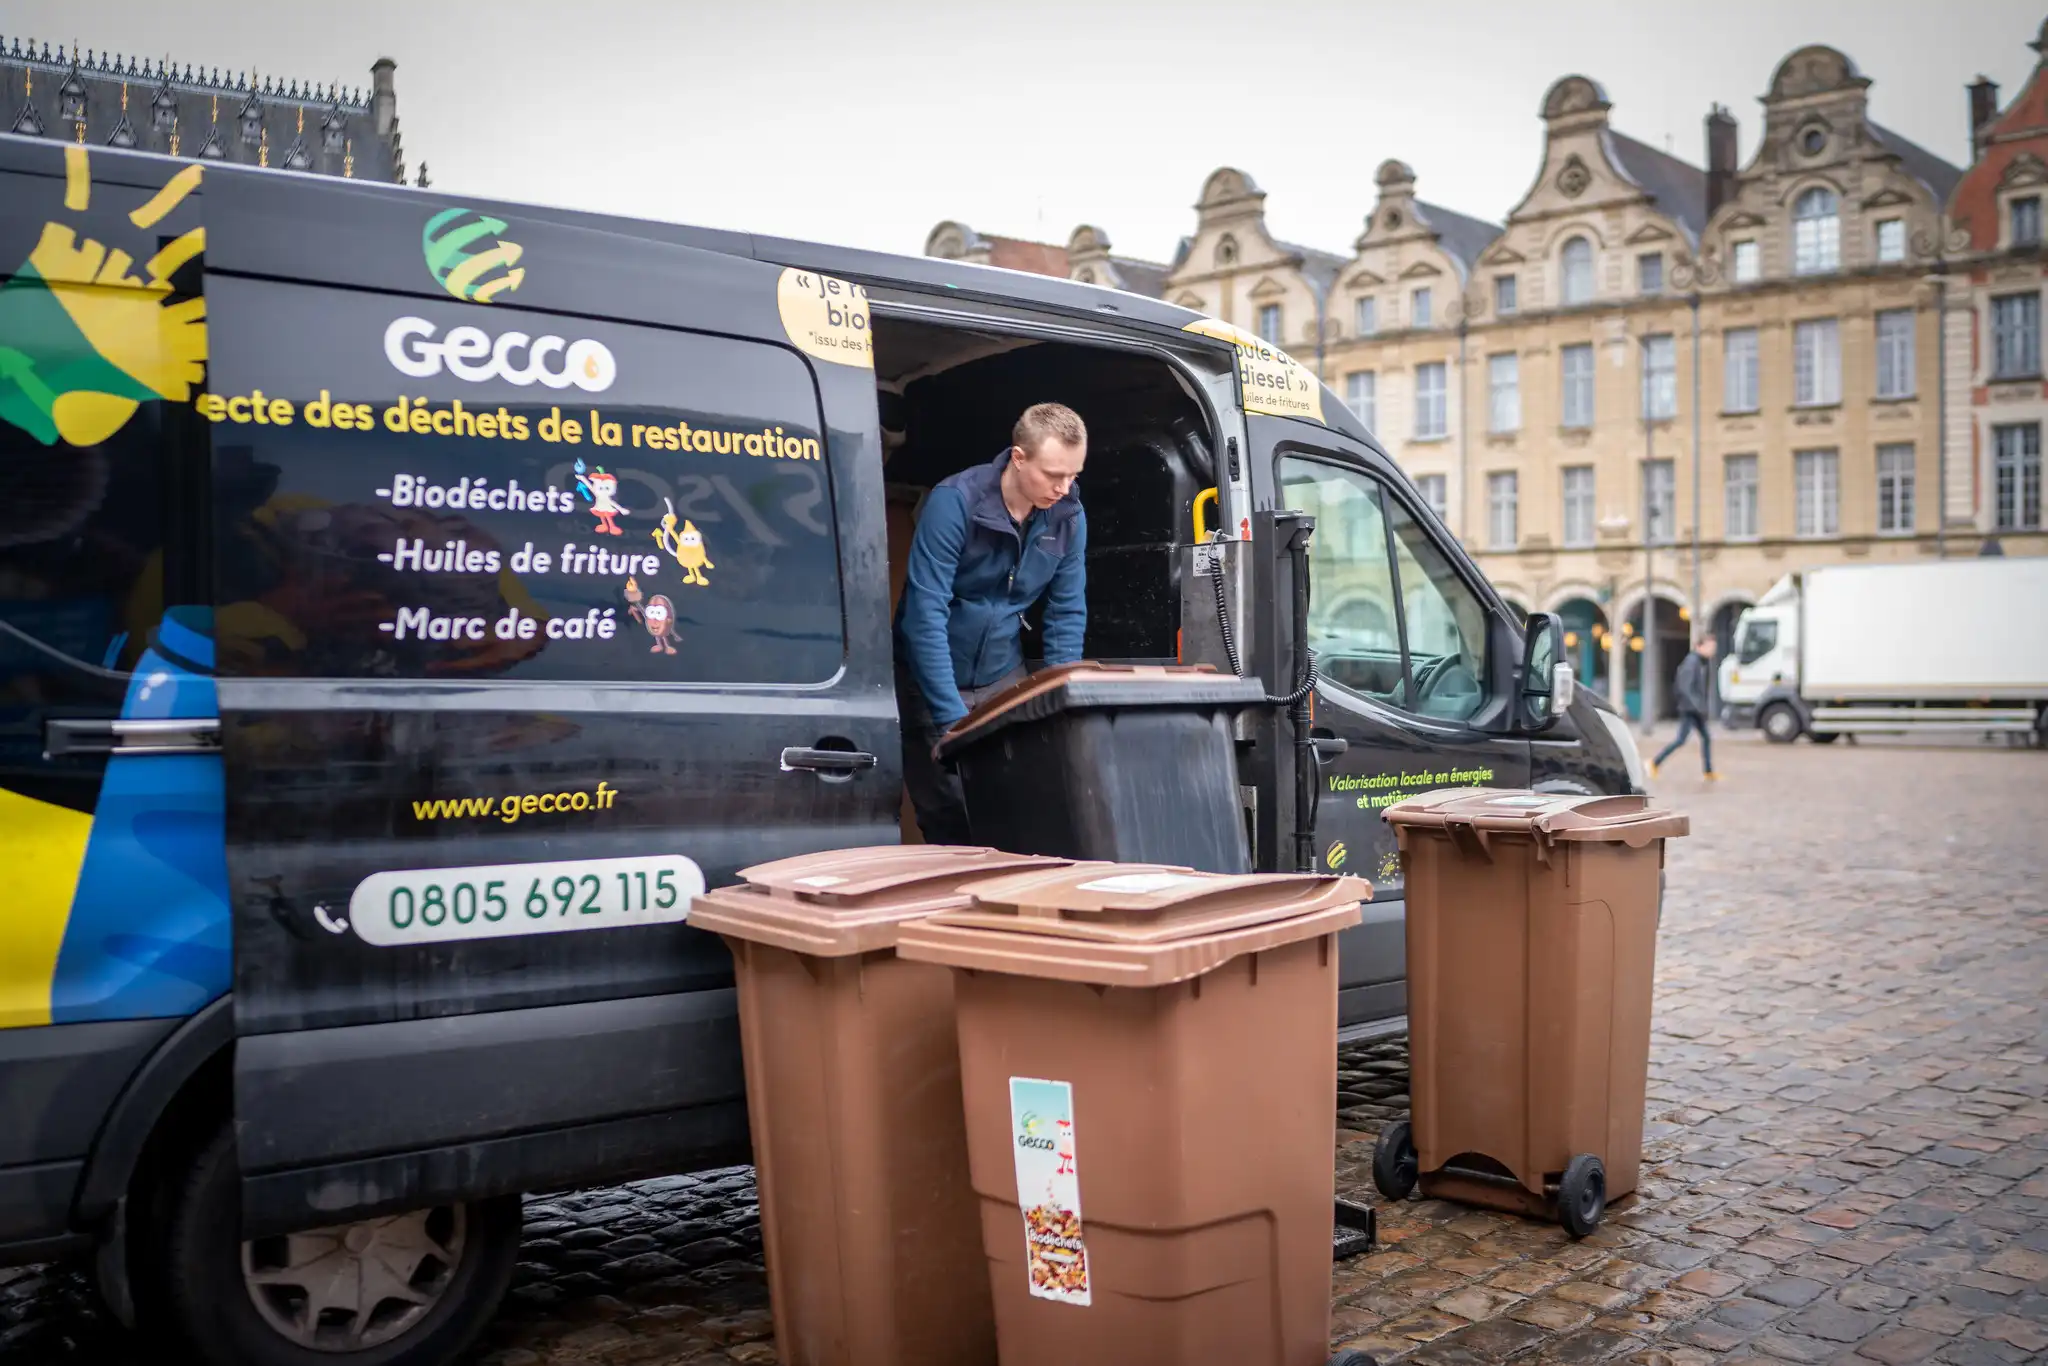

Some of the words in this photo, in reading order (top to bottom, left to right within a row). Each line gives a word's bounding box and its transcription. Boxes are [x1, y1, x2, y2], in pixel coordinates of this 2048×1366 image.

[826, 300, 871, 330] bio
[841, 336, 863, 351] des
[1266, 394, 1277, 406] de
[1279, 396, 1310, 411] fritures
[303, 389, 375, 431] des
[383, 394, 530, 441] déchets
[537, 405, 584, 445] de
[590, 407, 624, 447] la
[631, 420, 821, 461] restauration
[510, 541, 552, 575] de
[561, 542, 661, 576] friture
[495, 607, 538, 640] de
[545, 607, 617, 640] café
[1328, 772, 1398, 791] Valorisation
[1400, 769, 1433, 786] locale
[1435, 772, 1449, 784] en
[1450, 766, 1493, 785] énergies
[412, 781, 619, 824] www.gecco.fr
[1356, 794, 1370, 809] et
[1371, 790, 1417, 808] matièr
[388, 880, 508, 930] 0805
[524, 873, 602, 920] 692
[616, 869, 678, 912] 115
